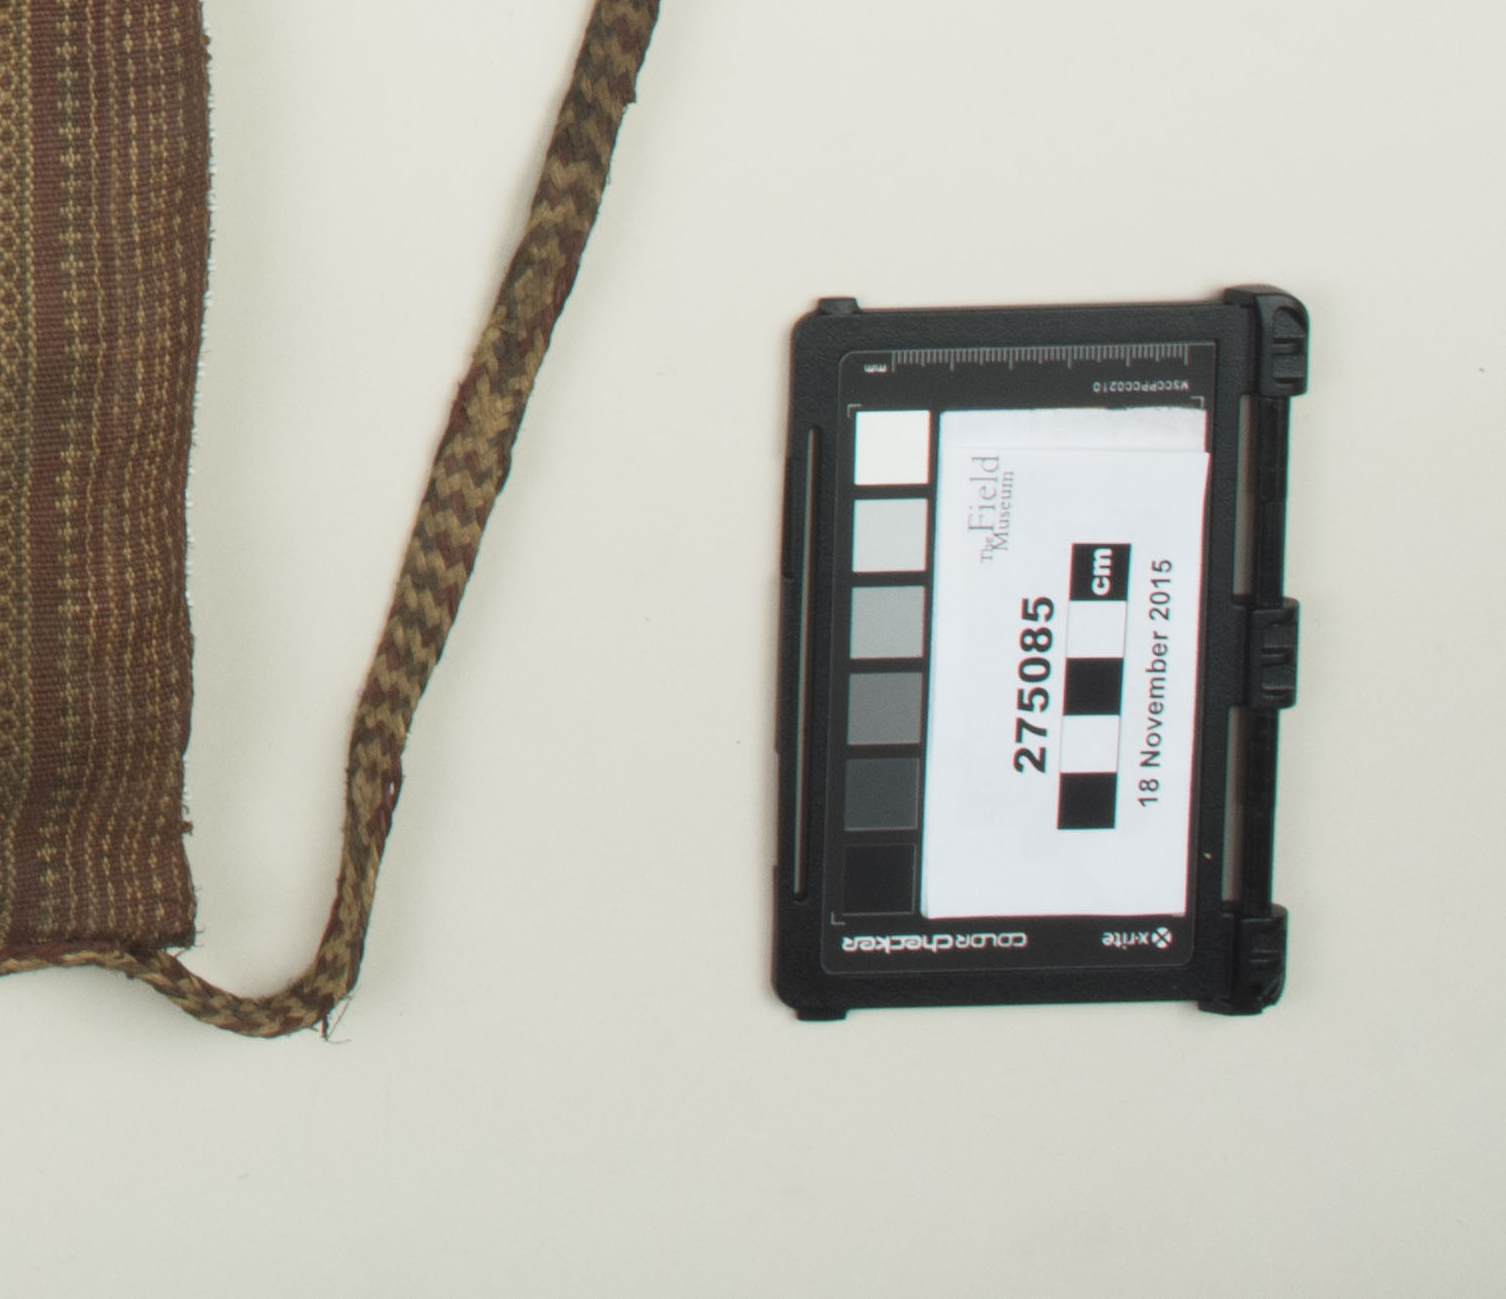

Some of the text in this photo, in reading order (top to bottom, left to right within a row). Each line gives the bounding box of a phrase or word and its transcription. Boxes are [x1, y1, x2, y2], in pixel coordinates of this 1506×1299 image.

[863, 362, 888, 374] mm
[967, 455, 1000, 565] The Field
[992, 470, 1015, 552] Museum
[1092, 548, 1113, 596] cm
[1013, 595, 1055, 774] 275085
[1139, 558, 1173, 808] 18 November 2015
